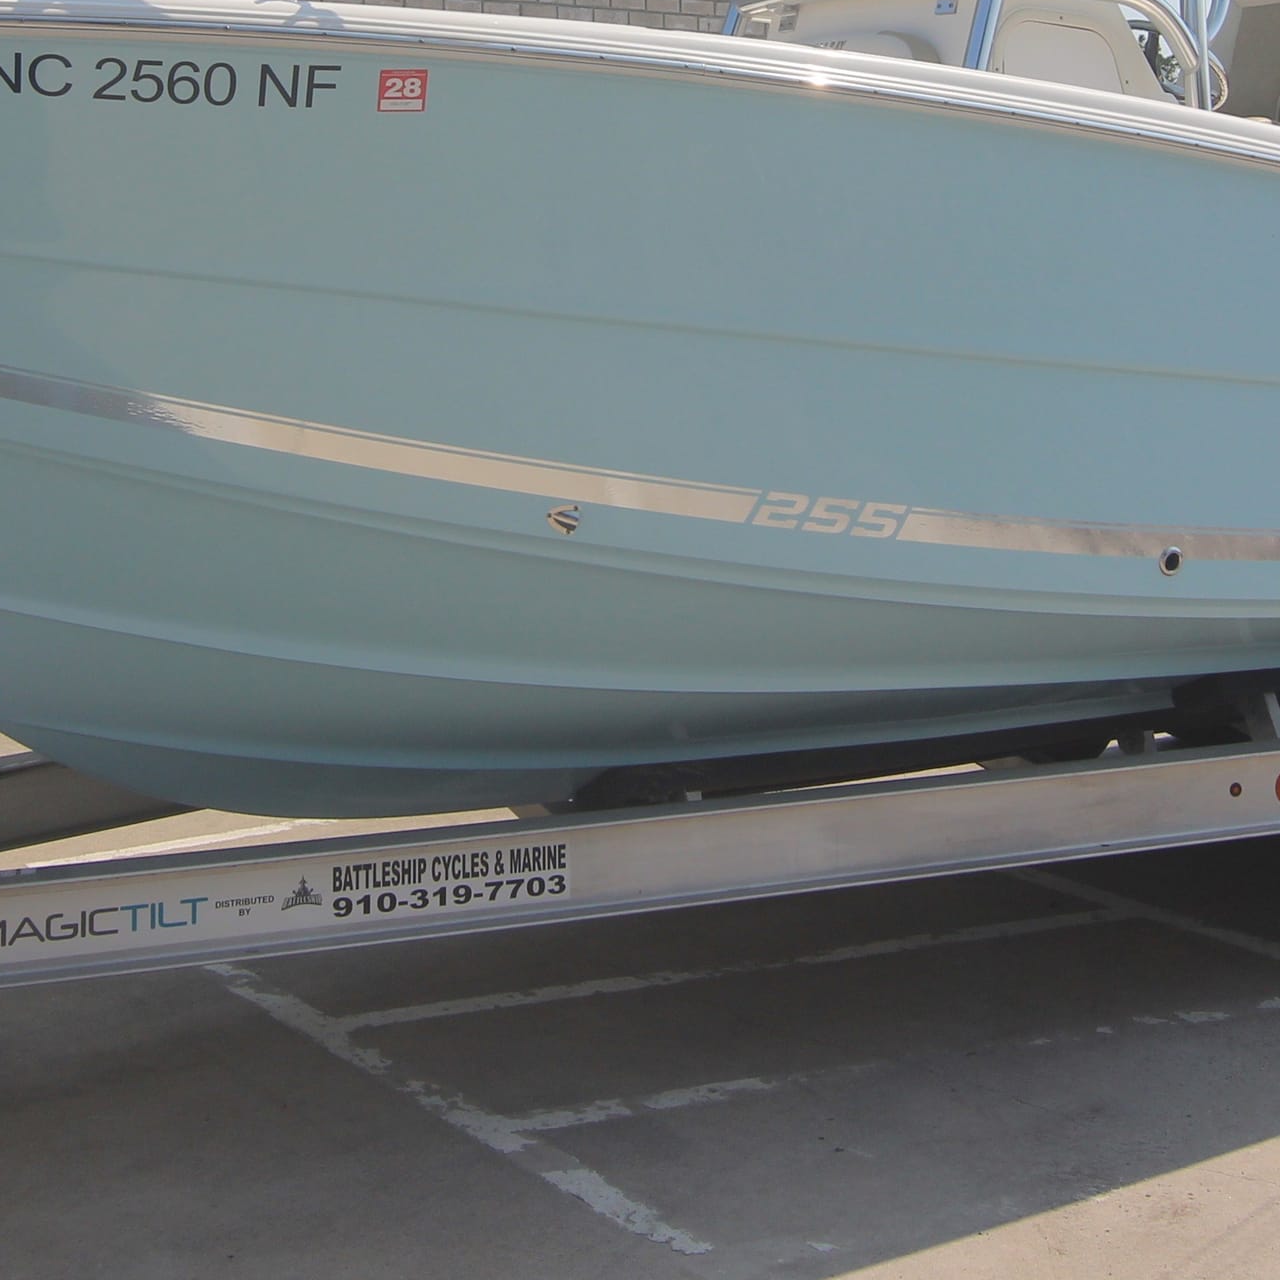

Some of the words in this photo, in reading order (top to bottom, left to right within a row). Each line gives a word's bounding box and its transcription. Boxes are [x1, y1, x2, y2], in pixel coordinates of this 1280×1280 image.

[93, 57, 237, 106] 2560
[257, 63, 342, 108] NF
[384, 77, 422, 98] 28
[752, 491, 907, 538] 255
[332, 858, 426, 892] BATTLESHIP
[432, 851, 489, 882] CYCLES
[494, 850, 505, 875] &
[510, 844, 567, 874] MARINE
[215, 895, 274, 909] DISTRIBUTED
[239, 908, 251, 917] BY
[332, 874, 566, 917] 910-319-7703
